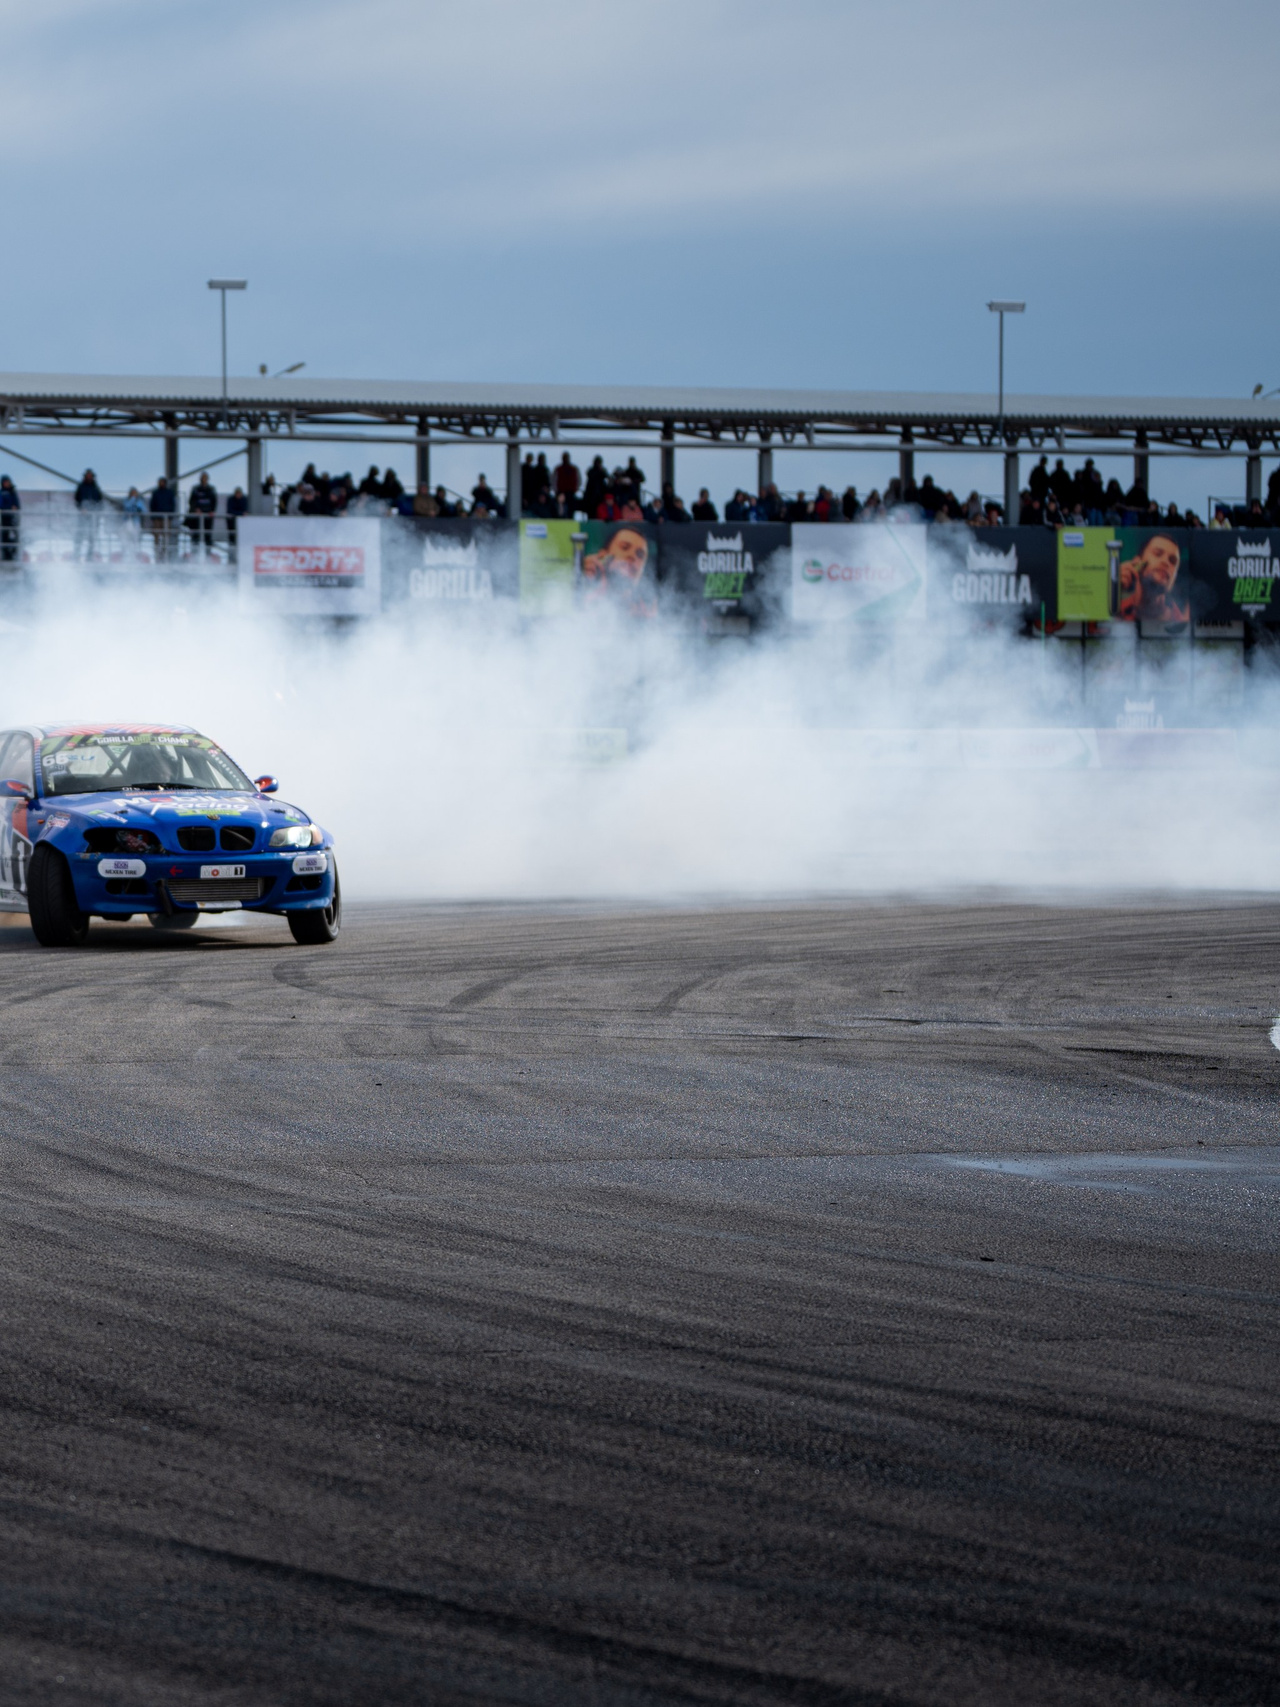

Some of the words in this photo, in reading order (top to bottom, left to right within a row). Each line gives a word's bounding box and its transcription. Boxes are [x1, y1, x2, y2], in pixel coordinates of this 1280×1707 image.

[258, 549, 360, 572] SPORT+
[697, 552, 754, 573] GORILLA
[1228, 556, 1280, 579] GORILLA
[410, 568, 494, 599] GORILLA
[703, 573, 746, 597] DRIFT
[952, 573, 1033, 604] GORILLA
[1233, 578, 1274, 602] DRIFT
[96, 736, 134, 744] GORILLA
[158, 736, 189, 745] CHAMP
[42, 754, 68, 767] 66
[150, 802, 250, 816] Racing
[203, 865, 232, 876] Mobil
